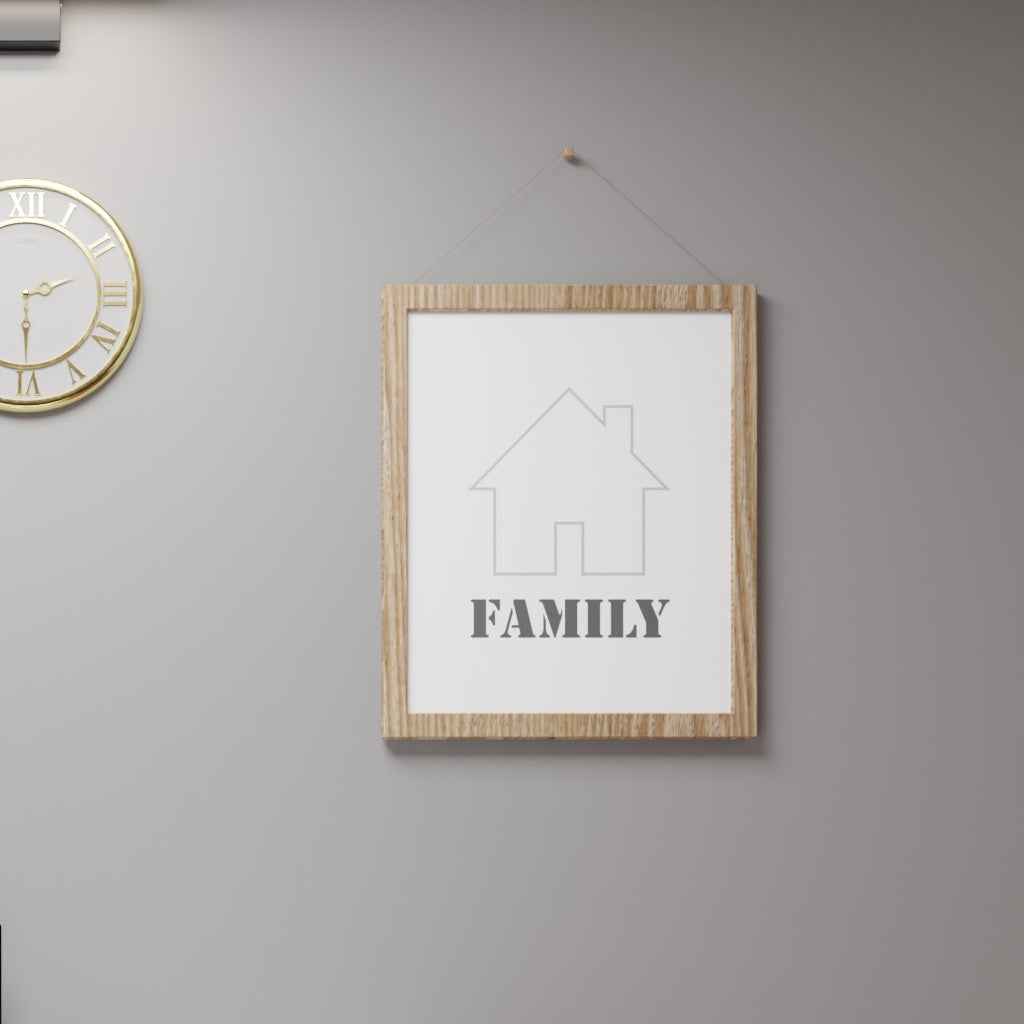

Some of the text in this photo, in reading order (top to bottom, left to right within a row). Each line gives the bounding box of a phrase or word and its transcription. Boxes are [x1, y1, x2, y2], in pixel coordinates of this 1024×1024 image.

[8, 191, 45, 218] XII
[59, 202, 78, 227] I
[87, 233, 116, 259] II
[103, 281, 128, 308] III
[91, 322, 120, 353] IV
[16, 370, 41, 396] VI
[66, 359, 87, 385] V
[471, 599, 670, 638] FAMILY
